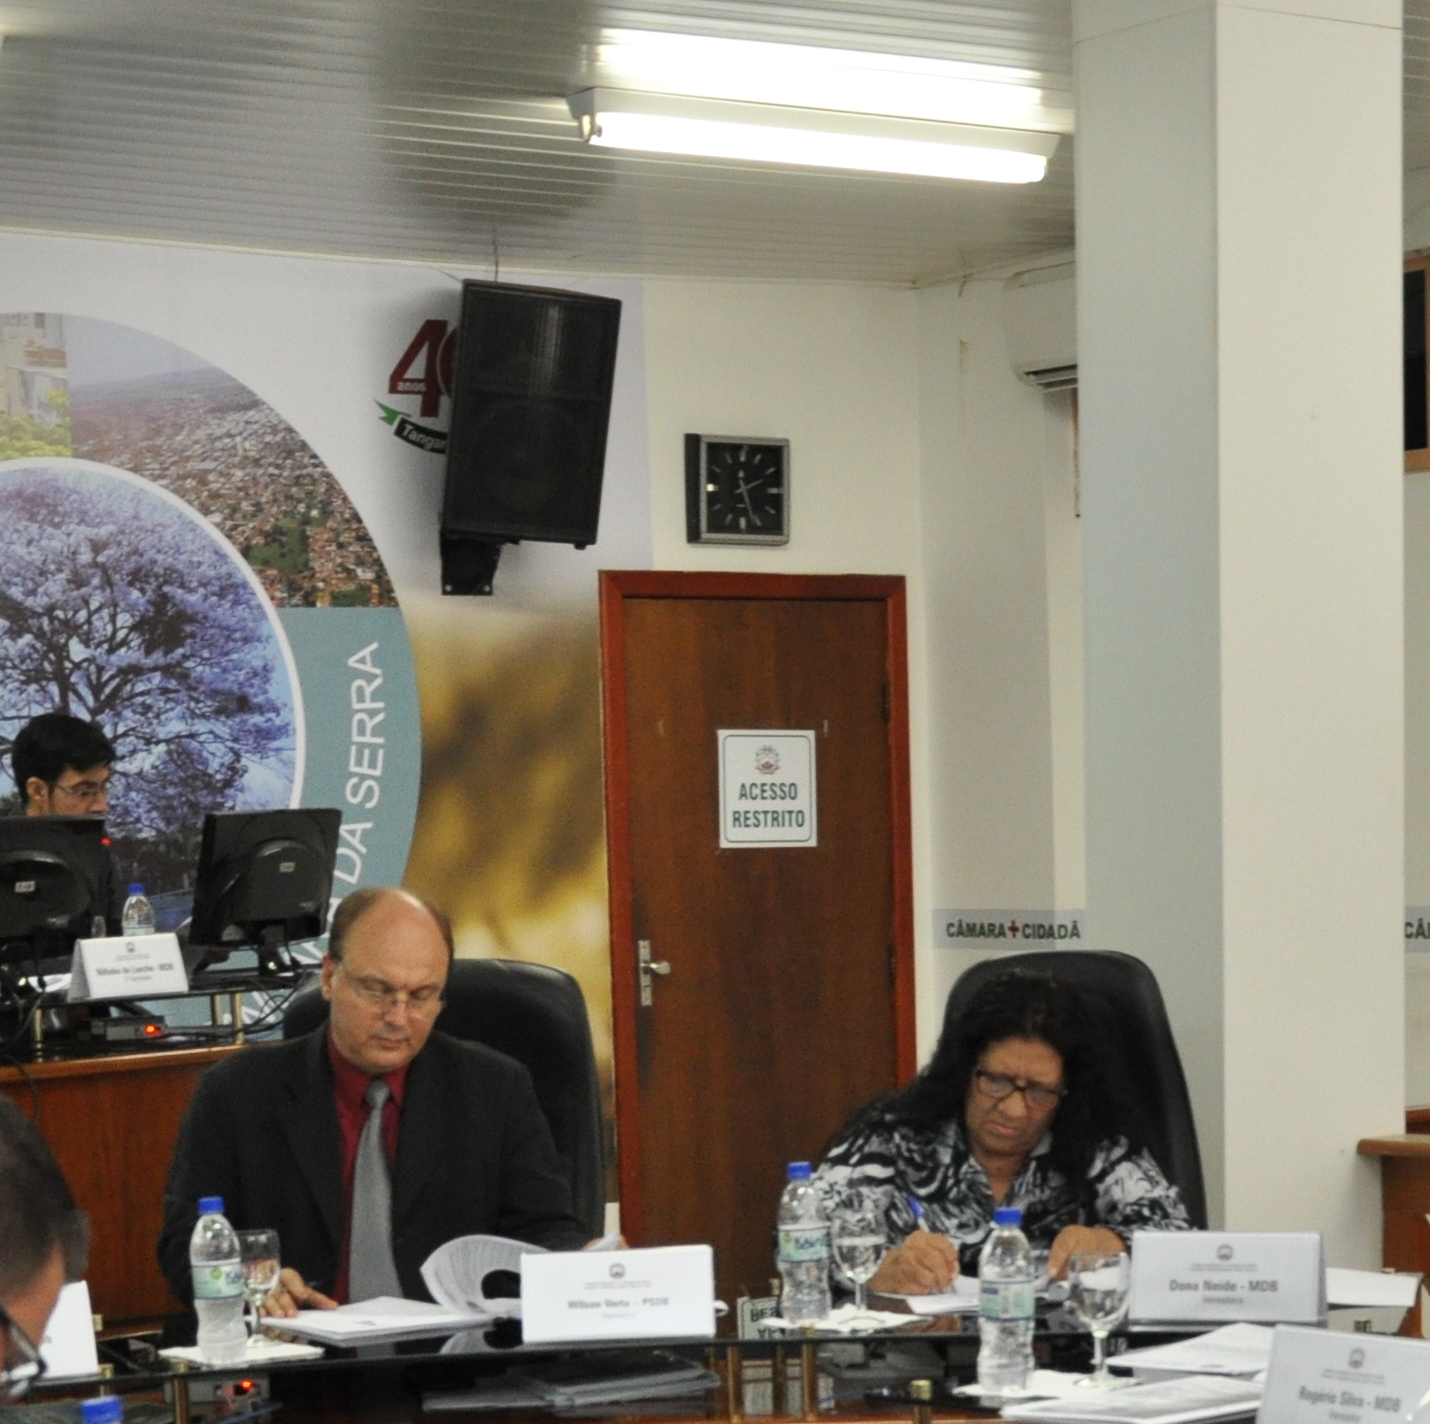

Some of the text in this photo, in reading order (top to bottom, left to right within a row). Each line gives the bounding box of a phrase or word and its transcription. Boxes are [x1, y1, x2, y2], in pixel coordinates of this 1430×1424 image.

[397, 381, 426, 392] anos
[345, 641, 386, 809] SERRA
[738, 781, 799, 803] ACESSO
[732, 808, 806, 831] RESTRITO
[946, 918, 1082, 941] CÂMARA CIDADÃ
[1169, 1279, 1200, 1292] Dona
[1202, 1279, 1238, 1293] Neide
[1248, 1280, 1279, 1293] MDB
